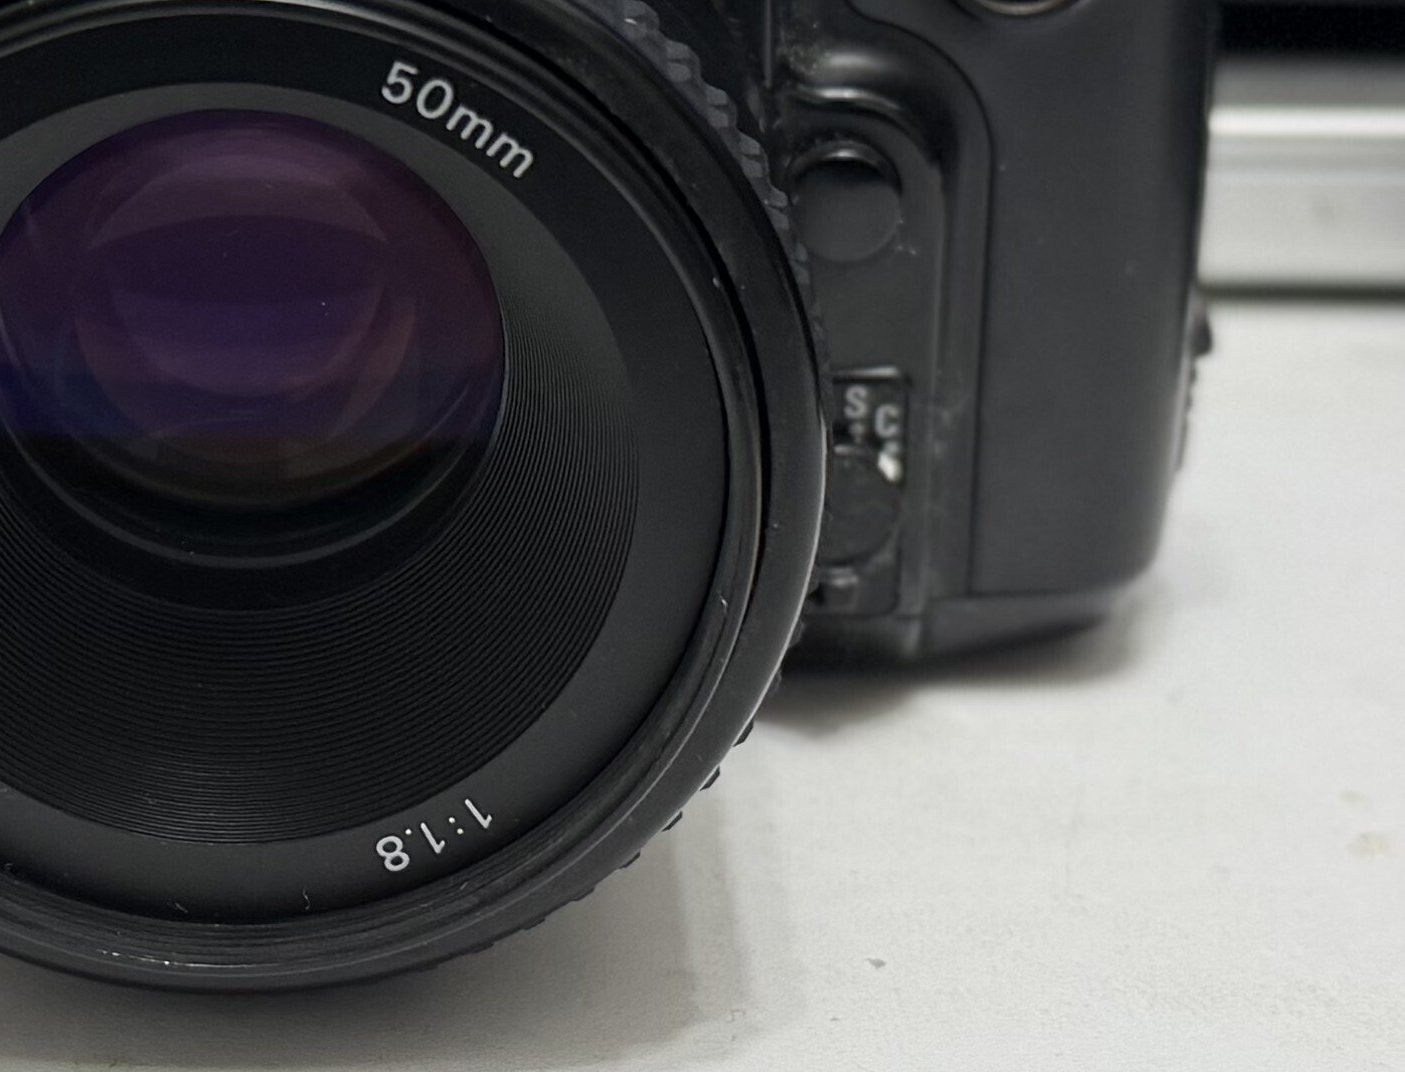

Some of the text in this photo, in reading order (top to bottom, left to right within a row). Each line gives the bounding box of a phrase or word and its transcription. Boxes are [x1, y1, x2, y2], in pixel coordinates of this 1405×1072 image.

[381, 60, 535, 178] 50mm
[844, 386, 868, 419] S
[875, 403, 899, 438] C
[375, 798, 493, 872] 1:1.8
